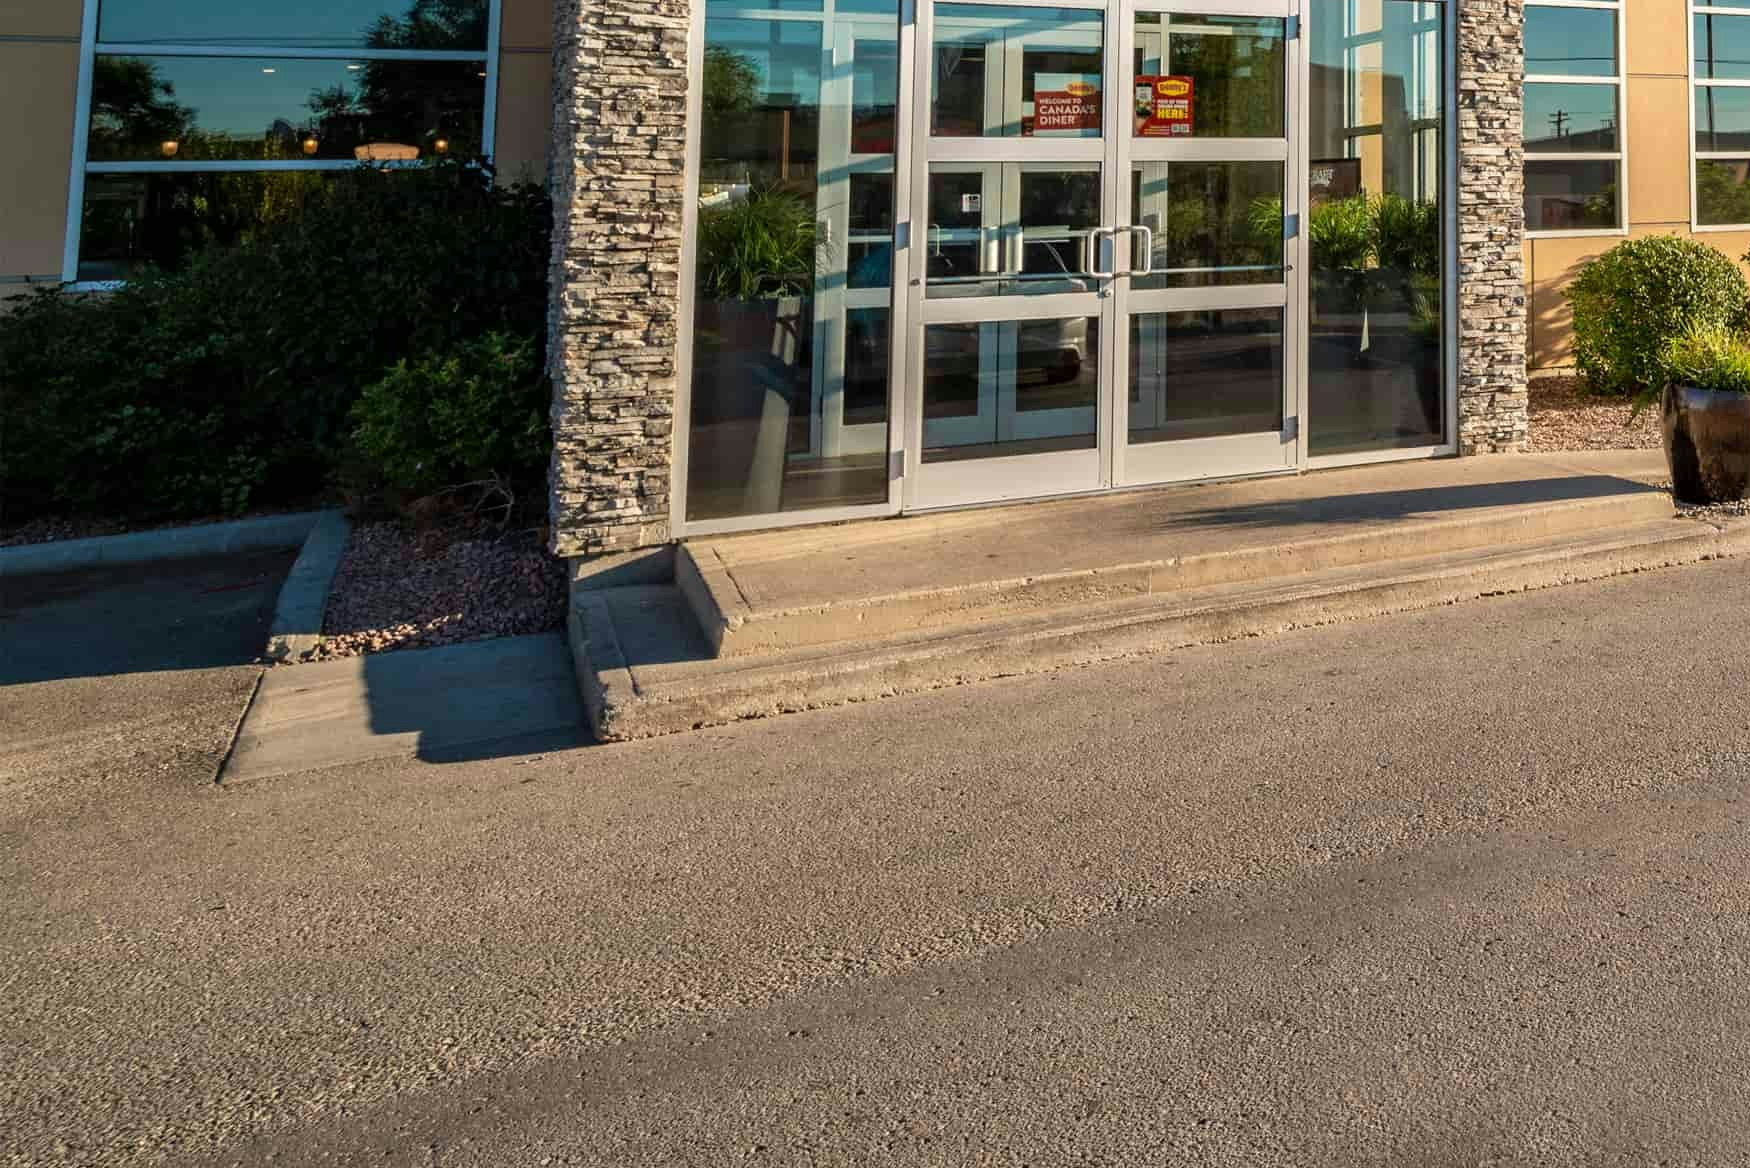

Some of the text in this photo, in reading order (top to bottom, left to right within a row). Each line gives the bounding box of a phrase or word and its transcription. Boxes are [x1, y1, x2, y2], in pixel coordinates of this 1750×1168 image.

[1039, 97, 1082, 105] WELCOME TO
[1039, 104, 1096, 115] CANADA'S
[1039, 115, 1075, 126] DINER
